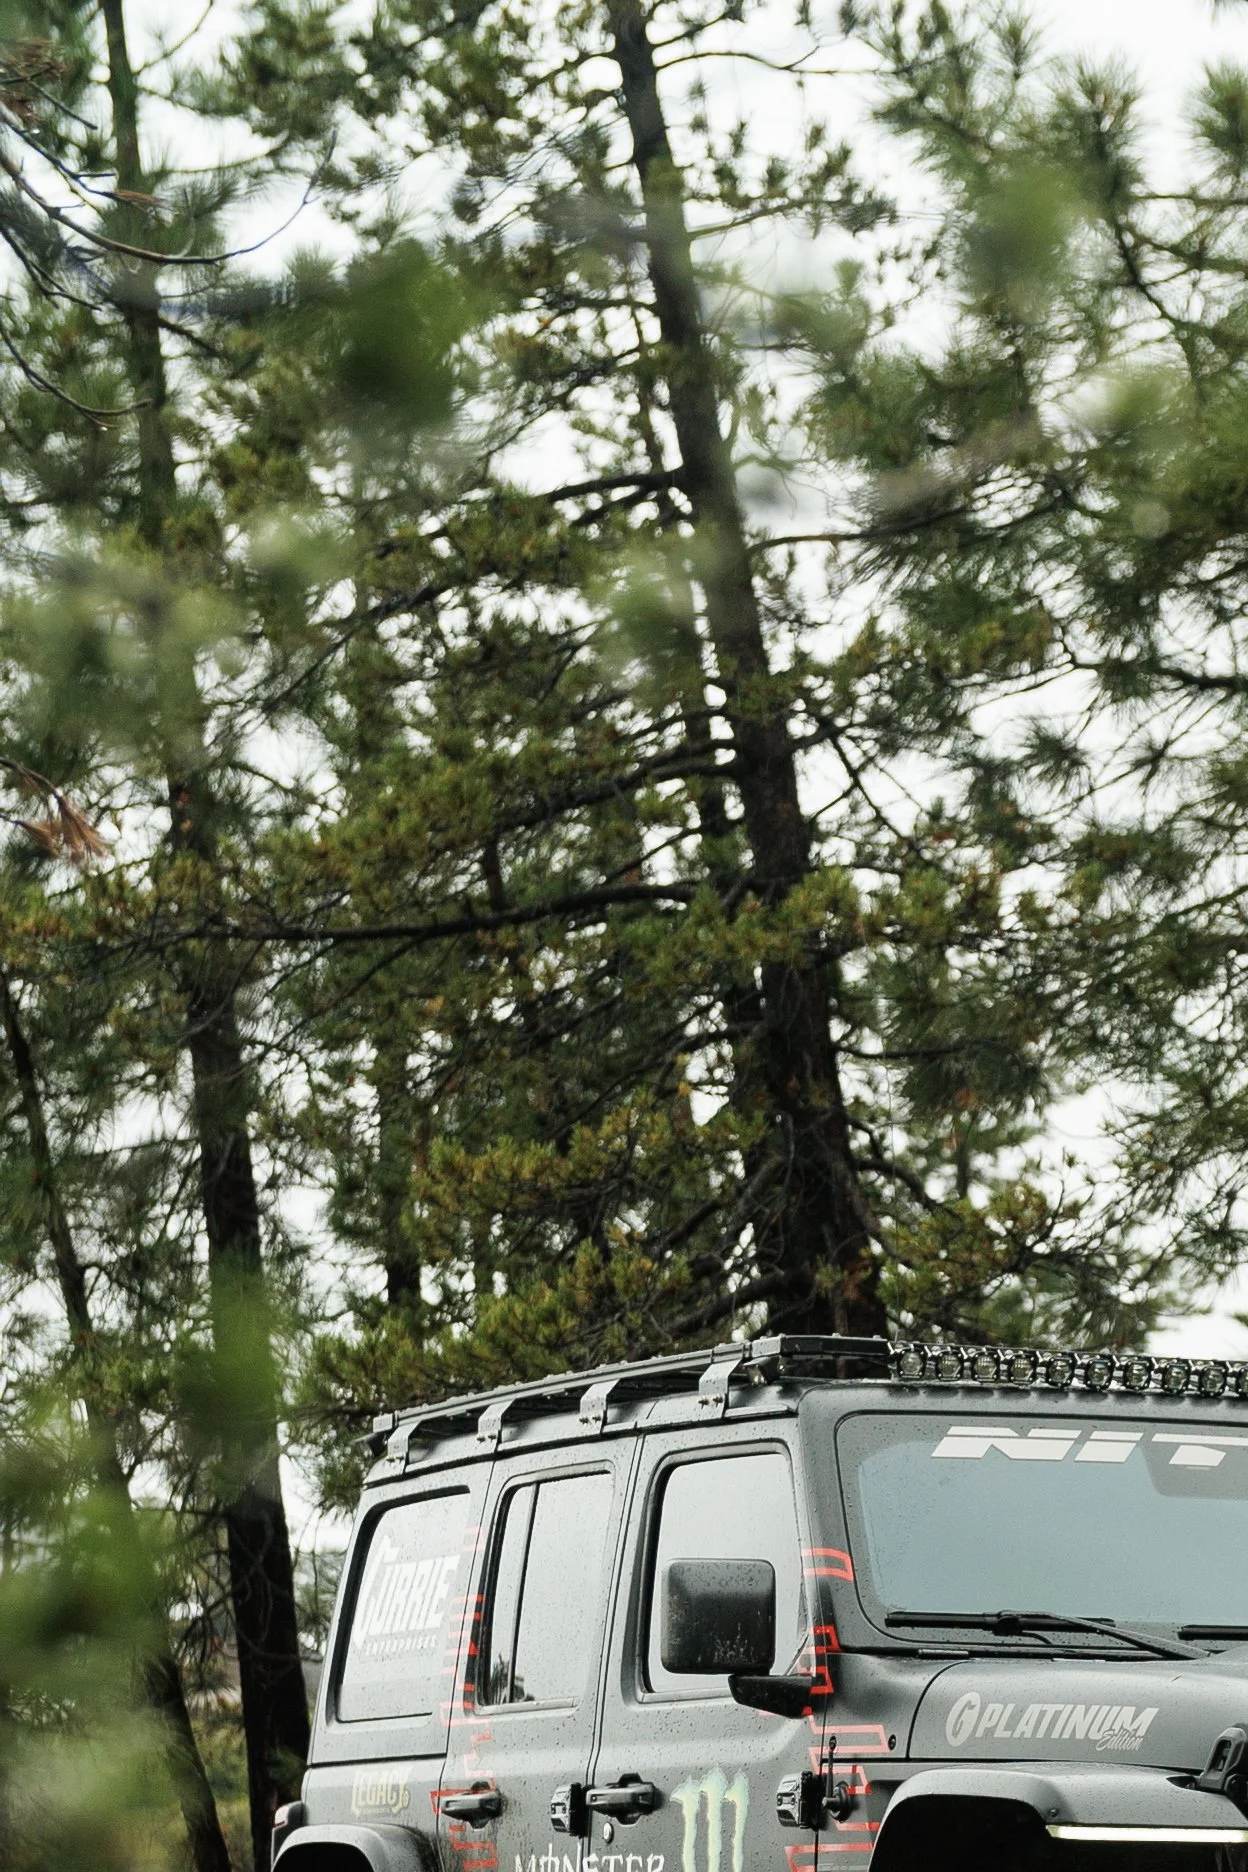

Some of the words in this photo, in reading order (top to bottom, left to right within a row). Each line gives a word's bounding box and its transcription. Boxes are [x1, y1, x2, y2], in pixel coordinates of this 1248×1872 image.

[353, 1534, 460, 1650] CURRIE
[974, 1703, 1159, 1740] PLATINUM
[1095, 1728, 1144, 1751] Edition
[351, 1768, 411, 1817] LEGACY
